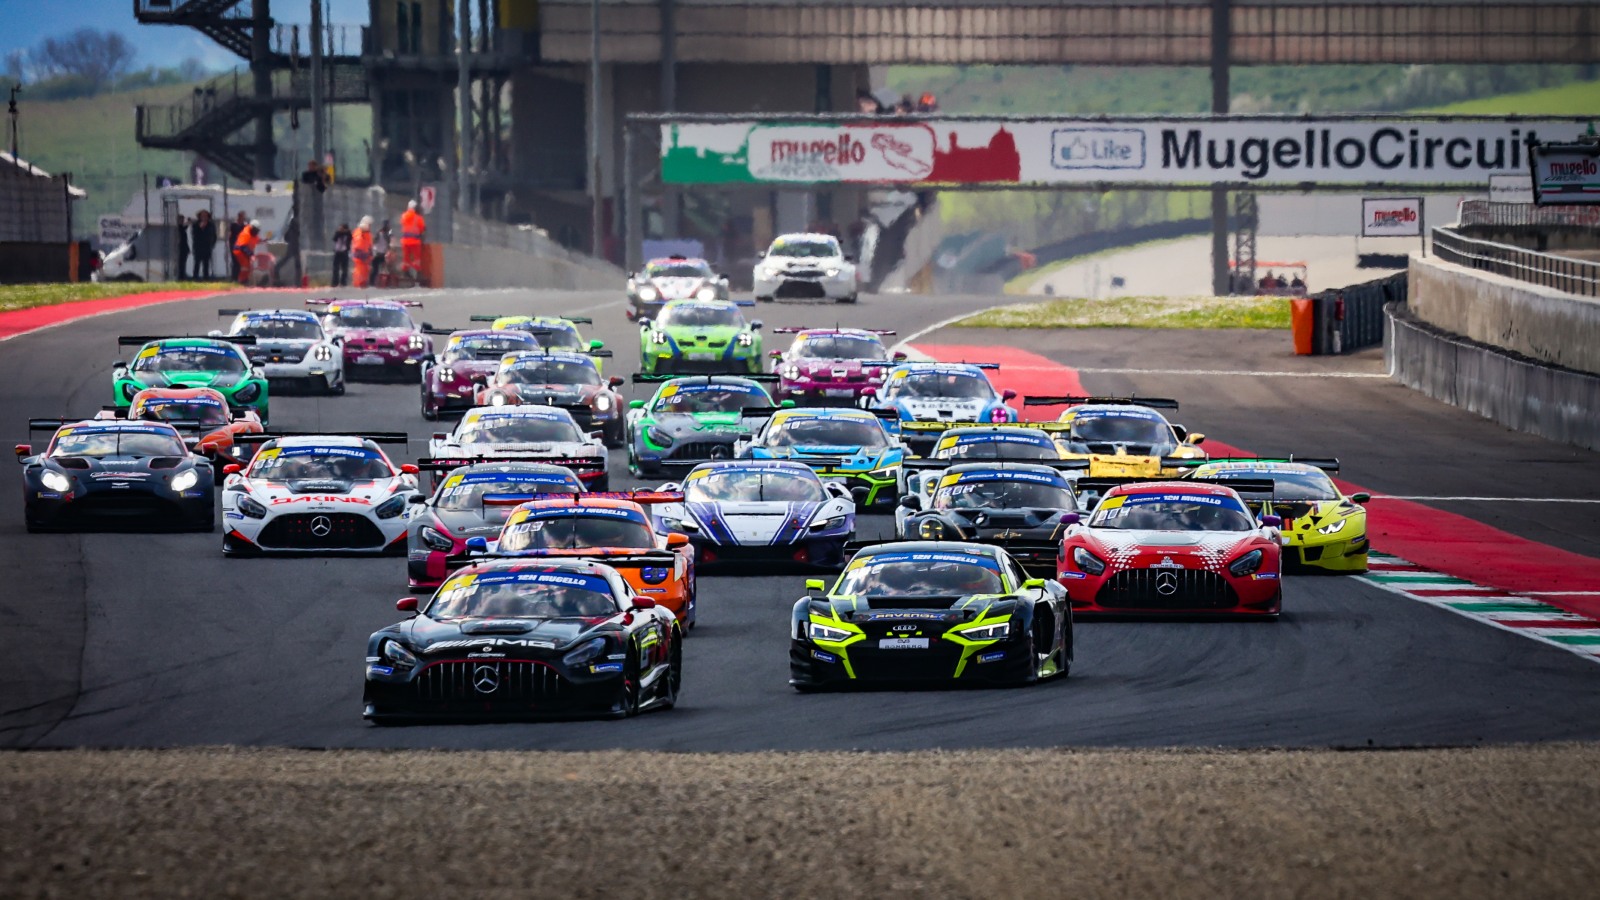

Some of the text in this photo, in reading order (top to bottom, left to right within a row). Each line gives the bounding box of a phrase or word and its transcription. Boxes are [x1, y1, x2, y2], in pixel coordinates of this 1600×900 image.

[1092, 140, 1131, 159] Like
[1550, 159, 1597, 175] mugello
[1180, 495, 1221, 505] MUGELLO
[585, 508, 628, 516] MUGELLO
[933, 554, 978, 564] MUGELLO
[539, 574, 586, 586] MUGELLO
[466, 638, 555, 649] AMG
